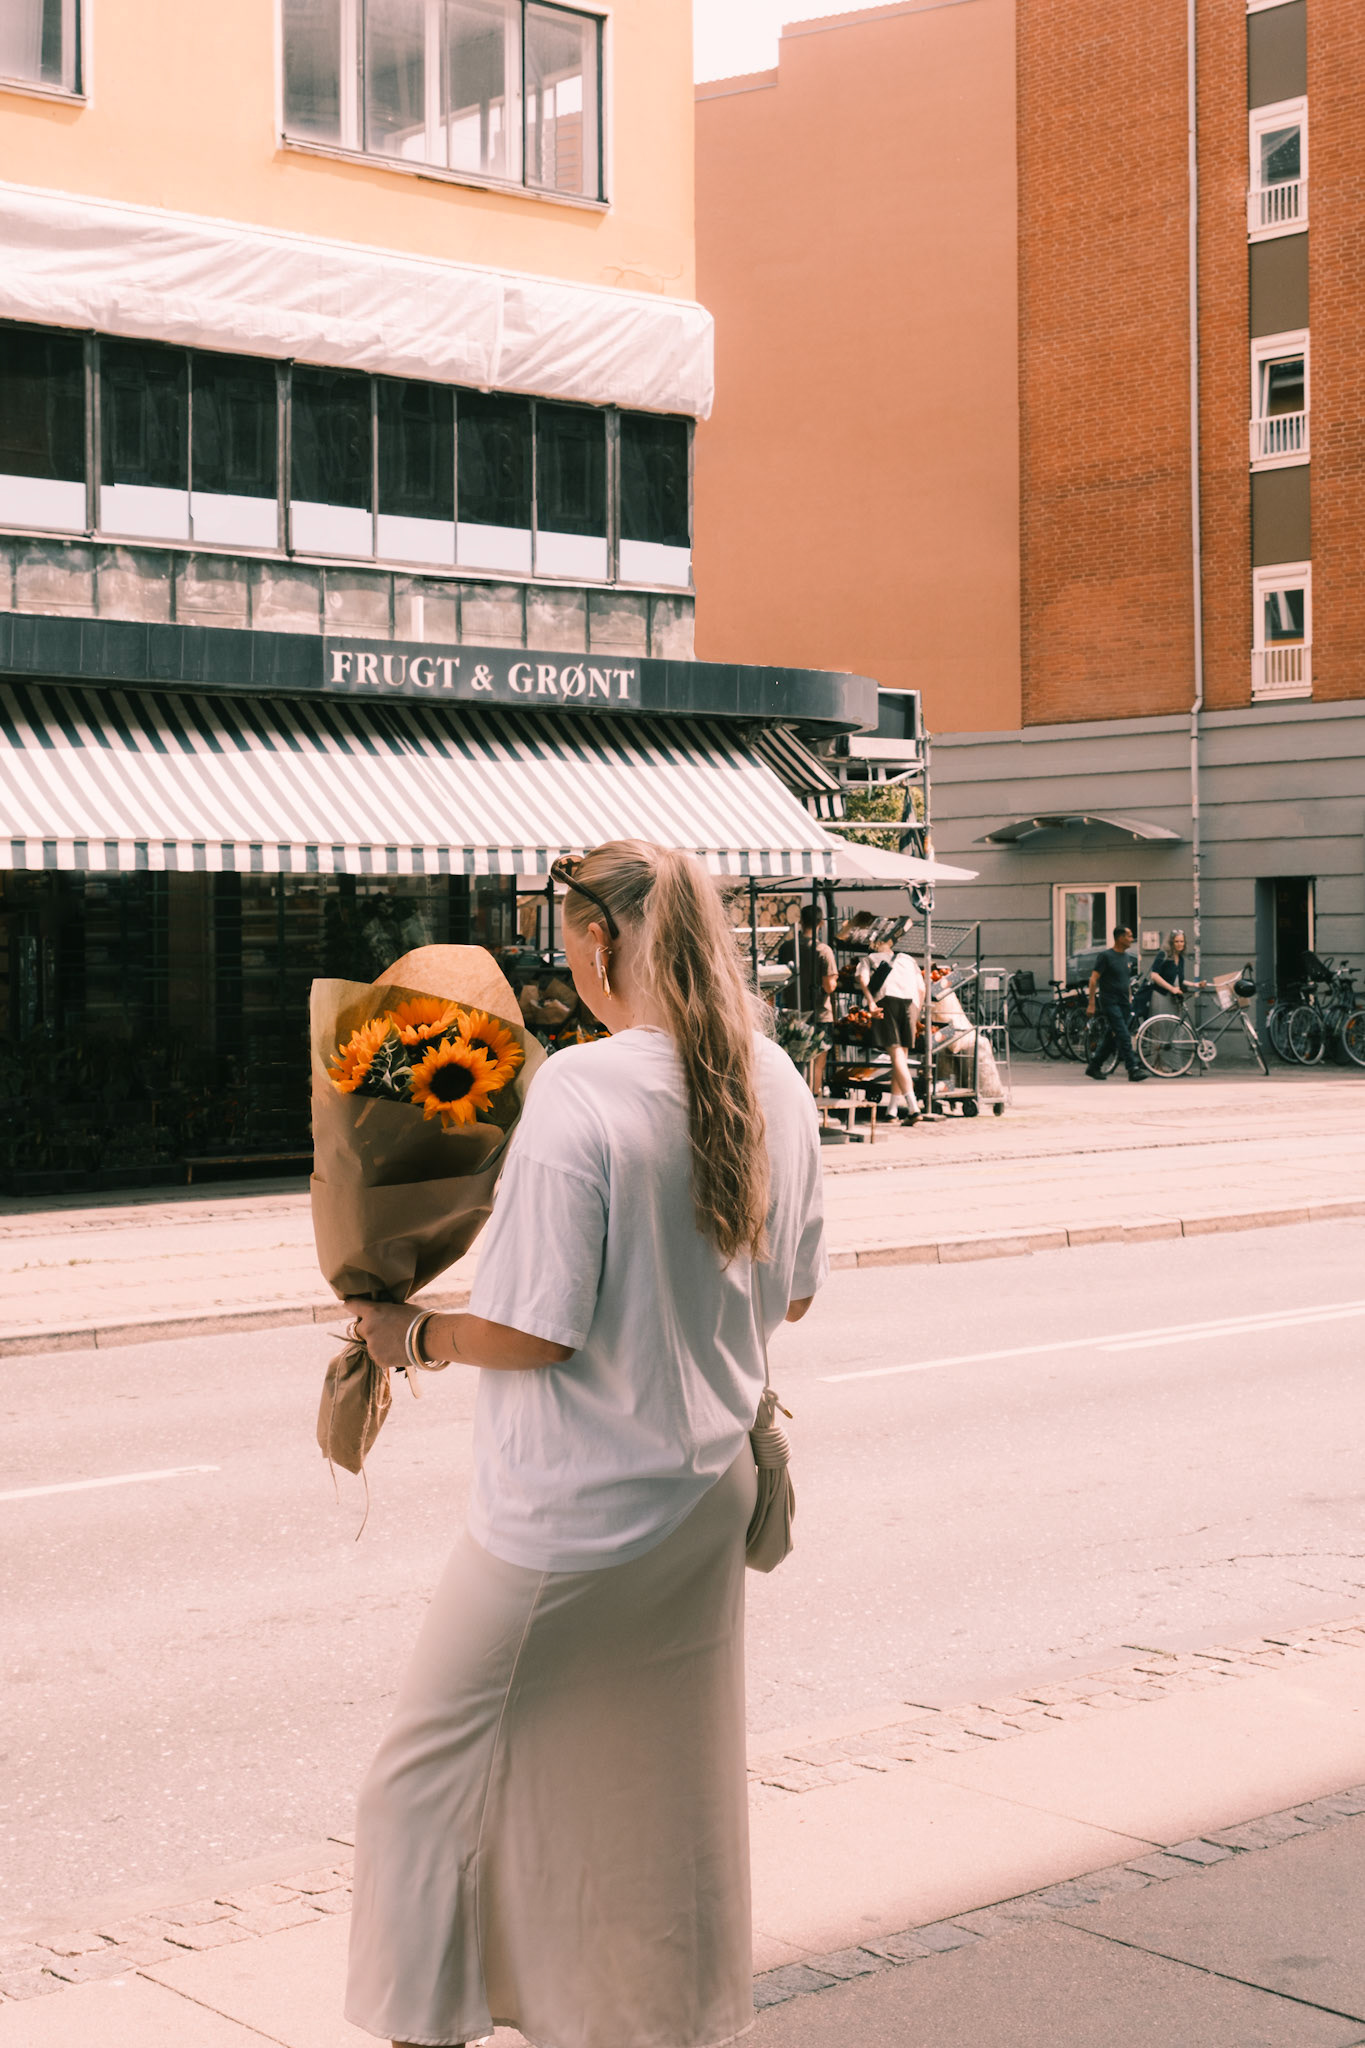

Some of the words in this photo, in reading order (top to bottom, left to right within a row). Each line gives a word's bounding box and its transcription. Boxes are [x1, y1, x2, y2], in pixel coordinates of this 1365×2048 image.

[330, 650, 460, 688] FRUGT
[470, 664, 494, 691] &
[507, 662, 635, 701] GRØNT
